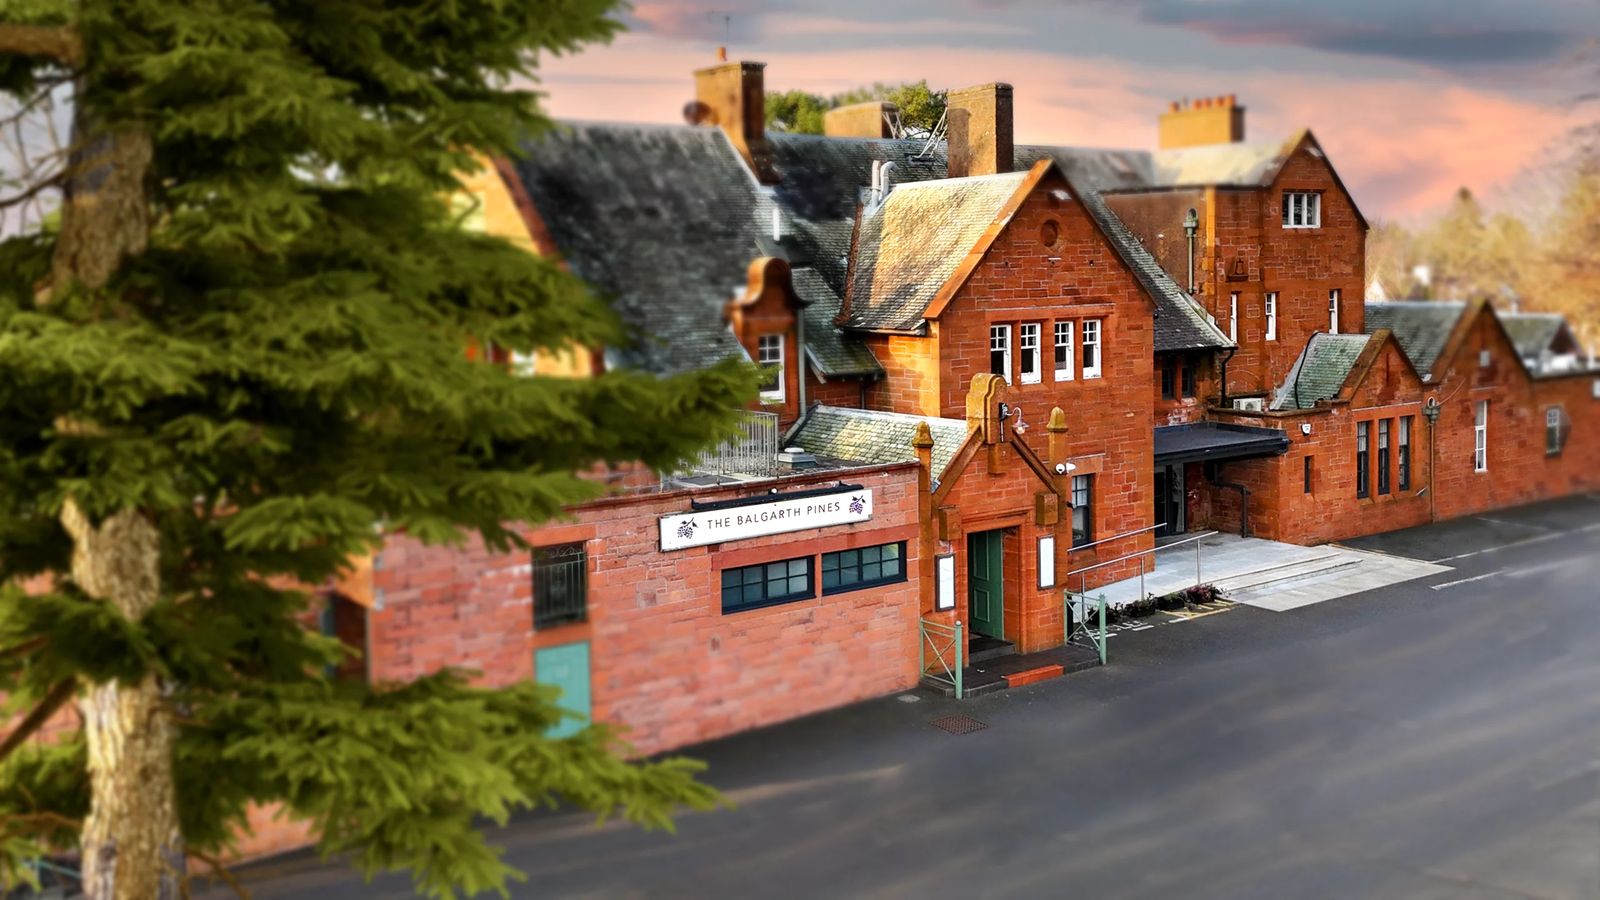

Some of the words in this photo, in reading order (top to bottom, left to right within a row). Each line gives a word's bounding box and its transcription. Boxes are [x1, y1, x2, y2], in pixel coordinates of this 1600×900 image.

[707, 516, 731, 529] THE
[737, 508, 801, 526] BALGARTH
[807, 501, 841, 515] PINES
